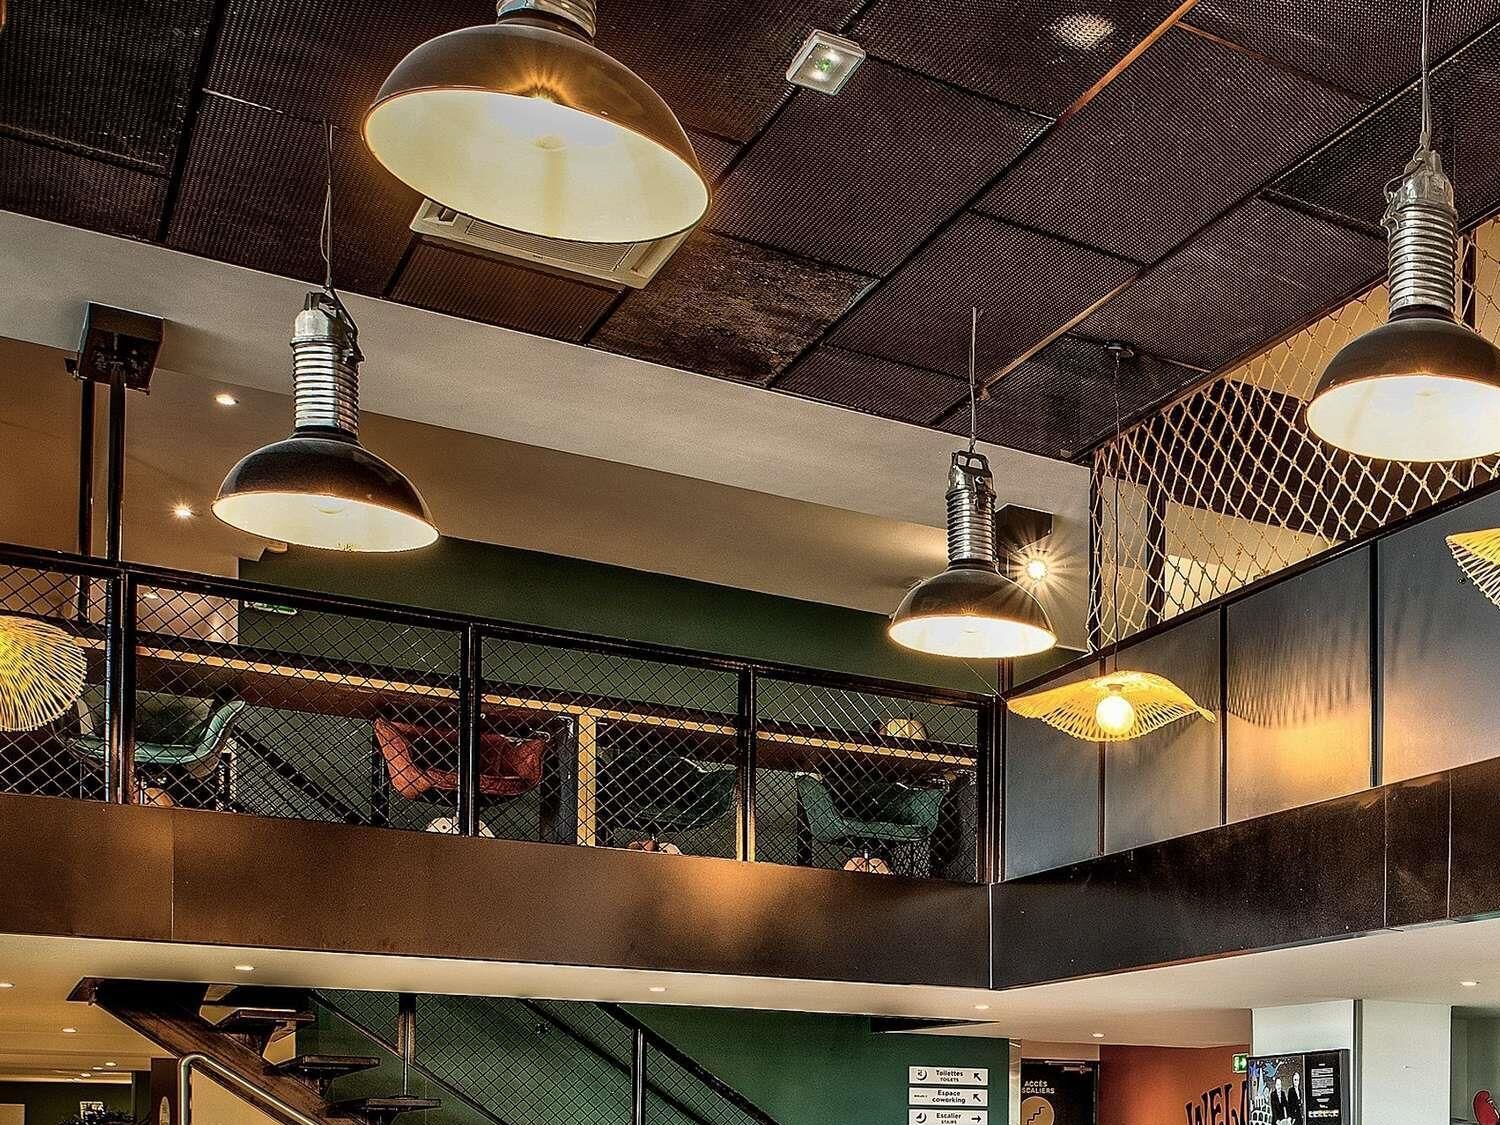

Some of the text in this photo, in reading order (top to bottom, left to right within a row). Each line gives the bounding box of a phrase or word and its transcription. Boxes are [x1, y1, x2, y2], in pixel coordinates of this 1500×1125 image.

[936, 1069, 964, 1078] Toilettes
[937, 1089, 961, 1098] Espace
[1021, 1087, 1055, 1095] SCALIERS
[931, 1096, 966, 1105] coworking
[936, 1112, 962, 1120] Escalier
